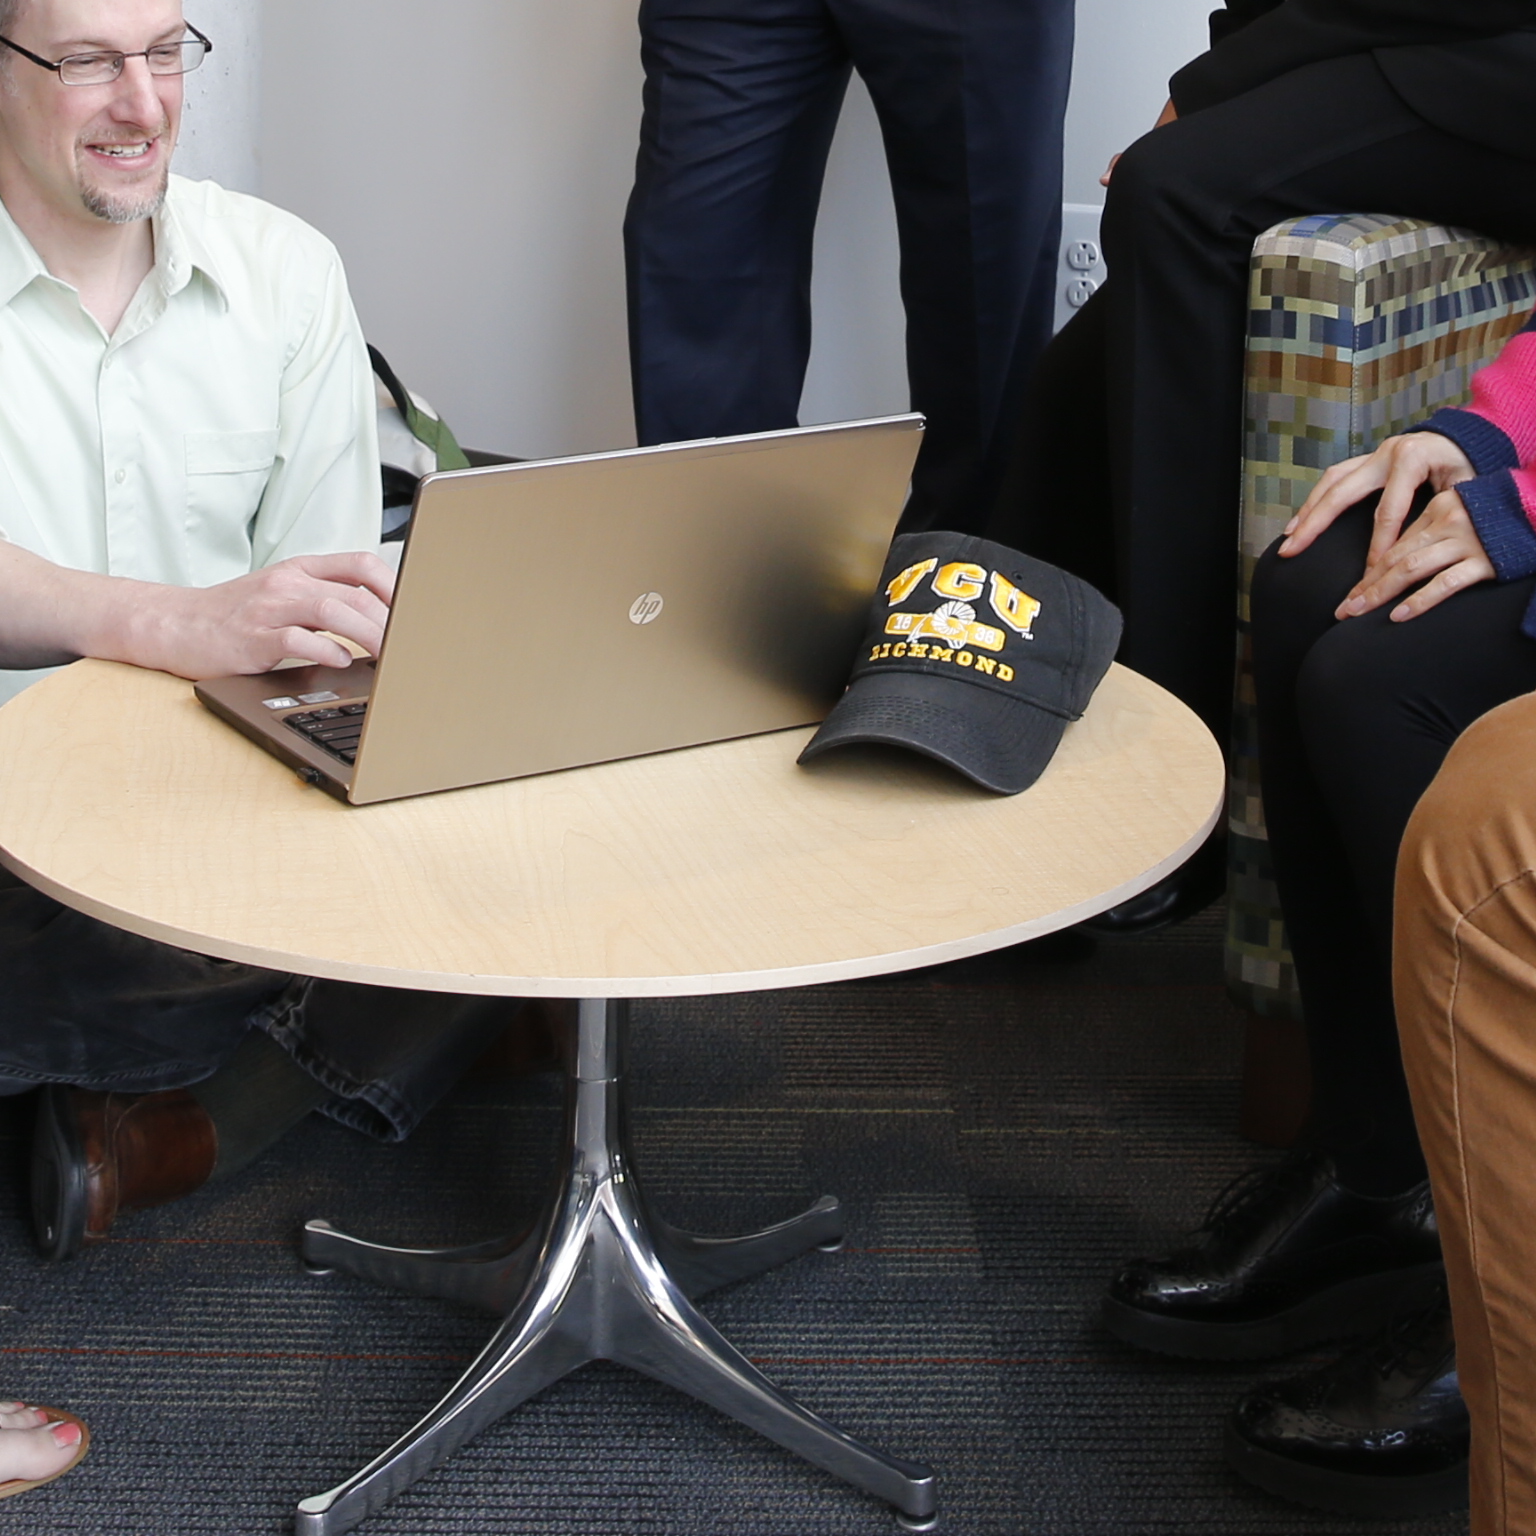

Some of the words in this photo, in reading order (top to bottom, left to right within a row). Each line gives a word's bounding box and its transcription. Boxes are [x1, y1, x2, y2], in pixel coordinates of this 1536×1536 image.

[632, 591, 662, 625] hp
[884, 557, 1042, 633] VCU
[893, 615, 912, 631] 18
[974, 626, 996, 645] 38
[869, 642, 1015, 682] RICHMOND
